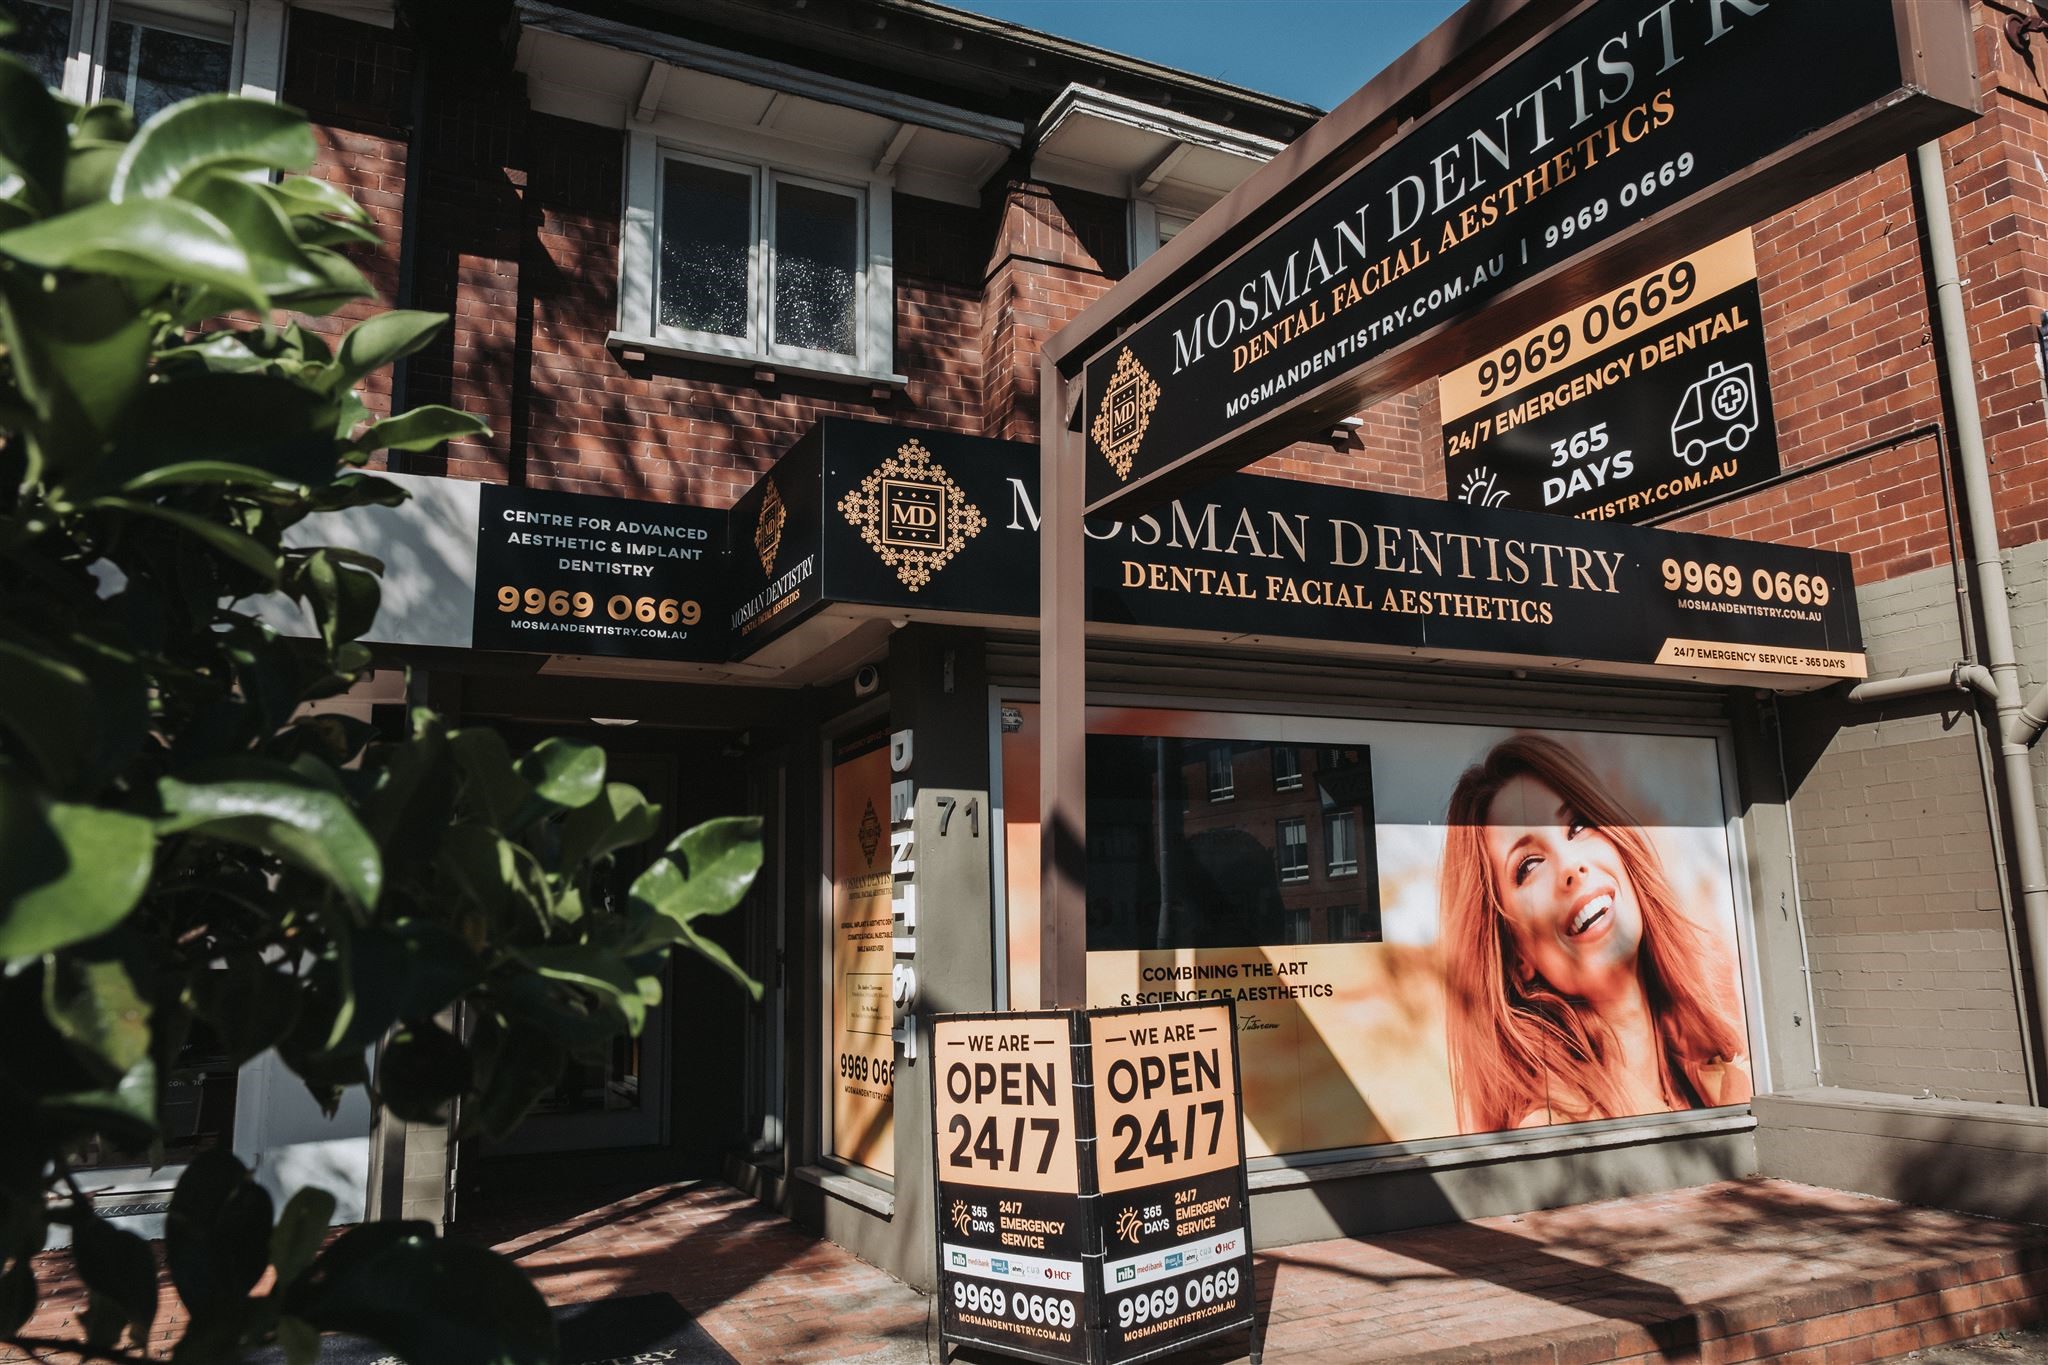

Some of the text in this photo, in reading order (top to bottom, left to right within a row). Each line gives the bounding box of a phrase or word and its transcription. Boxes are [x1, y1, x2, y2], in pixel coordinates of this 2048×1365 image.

[1233, 88, 1676, 373] DENTAL FACIAL AESTHETICS
[1172, 203, 1369, 375] MOSMAN
[1226, 253, 1504, 418] MOSMANDENTISTRY.COM.AU
[1545, 198, 1608, 248] 9969
[1620, 152, 1694, 207] 0669
[1478, 260, 1697, 397] 9969 0669
[1448, 306, 1748, 457] 24/7 EMERGENCY DENTAL
[1114, 400, 1135, 427] MD
[1550, 422, 1609, 467] 365
[1543, 449, 1634, 506] DAYS
[503, 509, 708, 541] CENTRE FOR ADVANCED
[891, 504, 937, 527] MD
[507, 532, 703, 560] AESTHETIC & IMPLANT
[1329, 519, 1624, 594] DENTISTRY
[558, 558, 654, 577] DENTISTRY
[731, 553, 814, 630] MOSMAN DENTISTRY
[1122, 560, 1553, 625] DENTAL FACIAL AESTHETICS
[1661, 558, 1829, 607] 9969 0669
[497, 585, 702, 626] 9969 0669
[1678, 598, 1822, 622] MOSMANDENTISTRY.COM.AU
[511, 619, 687, 640] MOSMANDENTISTRY.COM.AU
[1697, 648, 1756, 662] EMERGENCY
[1759, 653, 1798, 665] SERVICE
[1805, 657, 1821, 667] 365
[1823, 659, 1845, 669] DAYS
[936, 796, 978, 836] 71
[1142, 962, 1308, 982] COMBINING THE ART
[1120, 993, 1131, 1006] &
[1136, 989, 1207, 1005] SCIENCE
[1234, 984, 1333, 1001] AESTHETICS
[968, 1035, 1029, 1051] WE ARE
[1129, 1024, 1195, 1046] WE ARE
[841, 1053, 868, 1081] 9969
[1108, 1048, 1221, 1103] OPEN
[947, 1062, 1056, 1106] OPEN
[949, 1114, 1060, 1174] 24/7
[1112, 1100, 1224, 1174] 24/7
[971, 1205, 987, 1218] 365
[999, 1201, 1022, 1214] 24/7
[1175, 1189, 1197, 1205] 24/7
[1175, 1196, 1231, 1221] EMERGENCY
[973, 1220, 995, 1233] DAYS
[1000, 1216, 1065, 1235] EMERGENCY
[1143, 1205, 1162, 1219] 365
[1144, 1219, 1170, 1234] DAYS
[1176, 1216, 1216, 1237] SERVICE
[1001, 1232, 1045, 1249] SERVICE
[953, 1253, 966, 1266] nib
[1054, 1271, 1072, 1280] HCF
[1118, 1267, 1134, 1281] nib
[1223, 1240, 1236, 1252] HCF
[953, 1281, 1076, 1329] 9969 0669
[1118, 1267, 1239, 1328] 9969 0669
[959, 1312, 1071, 1343] MOSMANDENTISTRY.COM.AU
[1124, 1299, 1236, 1343] MOSMANDENTISTRY.COM.AU
